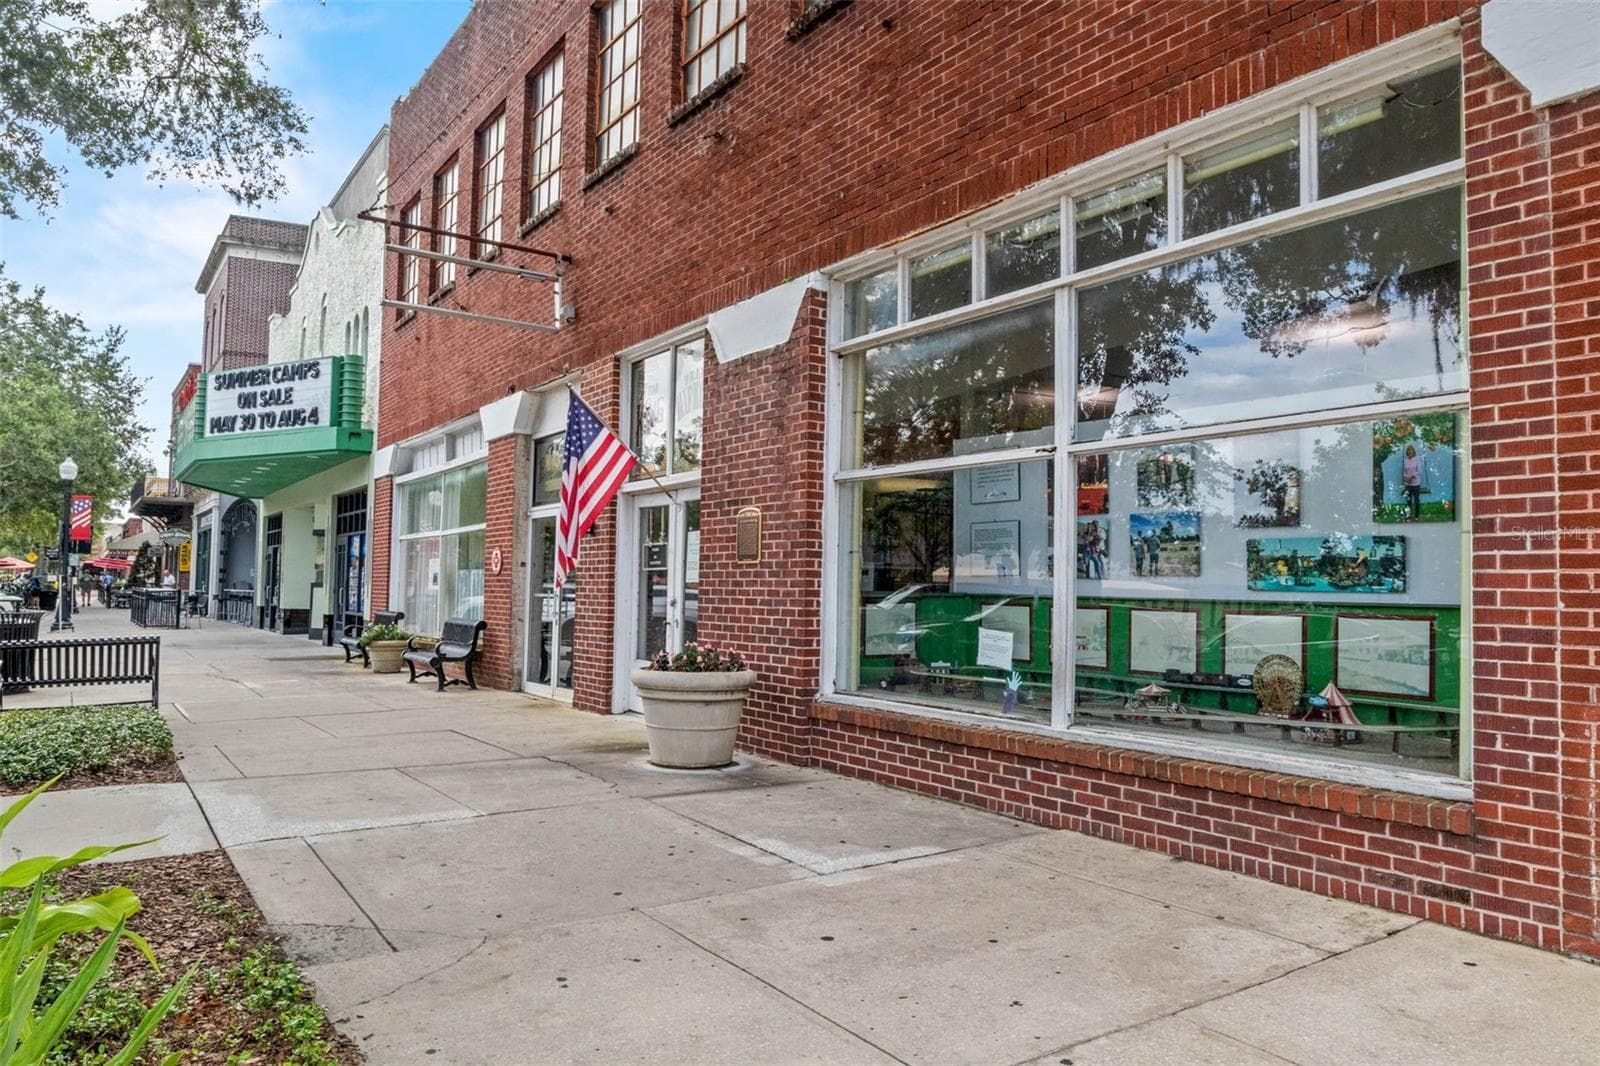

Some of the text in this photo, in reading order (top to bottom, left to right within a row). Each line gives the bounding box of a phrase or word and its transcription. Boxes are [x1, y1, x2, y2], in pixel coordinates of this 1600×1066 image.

[214, 360, 320, 391] SUMMER CAMPS
[237, 386, 294, 409] ON SALE
[209, 406, 319, 434] MAY 30 TO AUG 4
